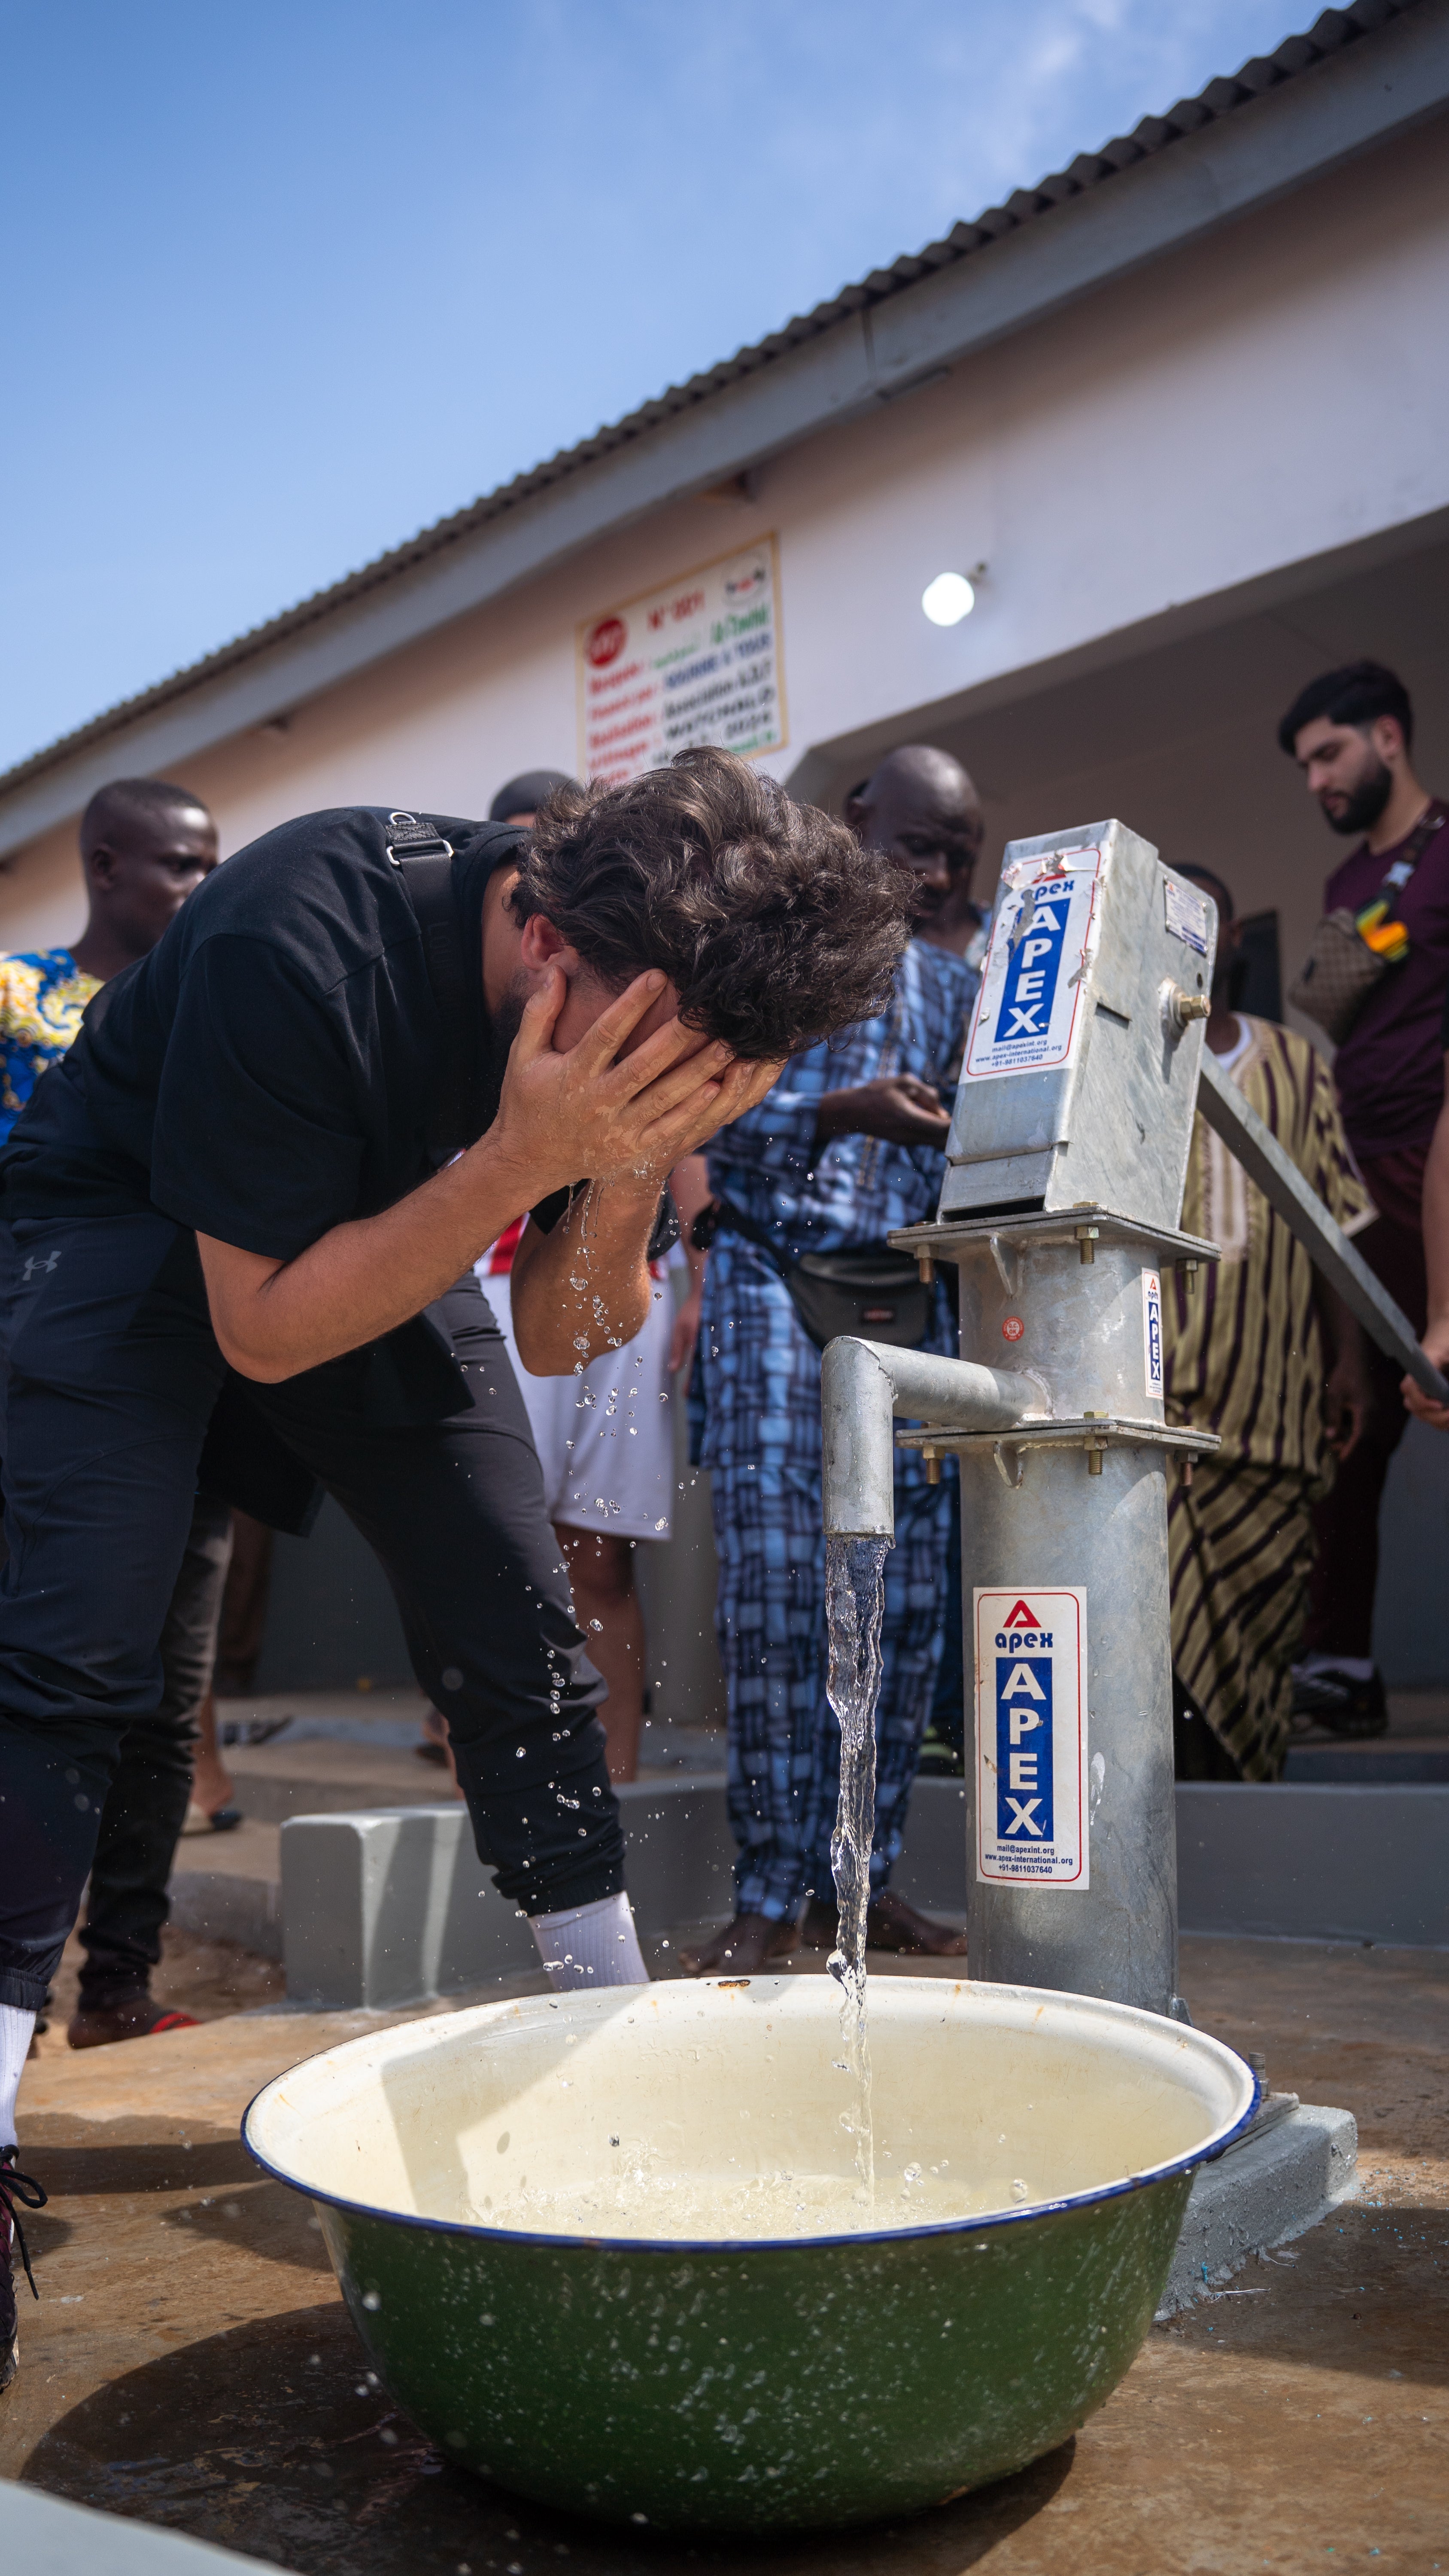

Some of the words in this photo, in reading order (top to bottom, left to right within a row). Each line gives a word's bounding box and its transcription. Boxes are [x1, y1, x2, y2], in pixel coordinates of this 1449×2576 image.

[1021, 880, 1075, 901] pex
[1003, 905, 1061, 1037] APEX
[992, 1039, 1047, 1052] mail@apexint.org
[1150, 1304, 1160, 1379] APEX
[995, 1633, 1053, 1653] apex
[1001, 1663, 1047, 1835] APEX
[985, 1853, 1073, 1865] www.apex-international.org
[997, 1845, 1054, 1855] mail@apexint.org
[999, 1864, 1052, 1873] +91-9811037640
